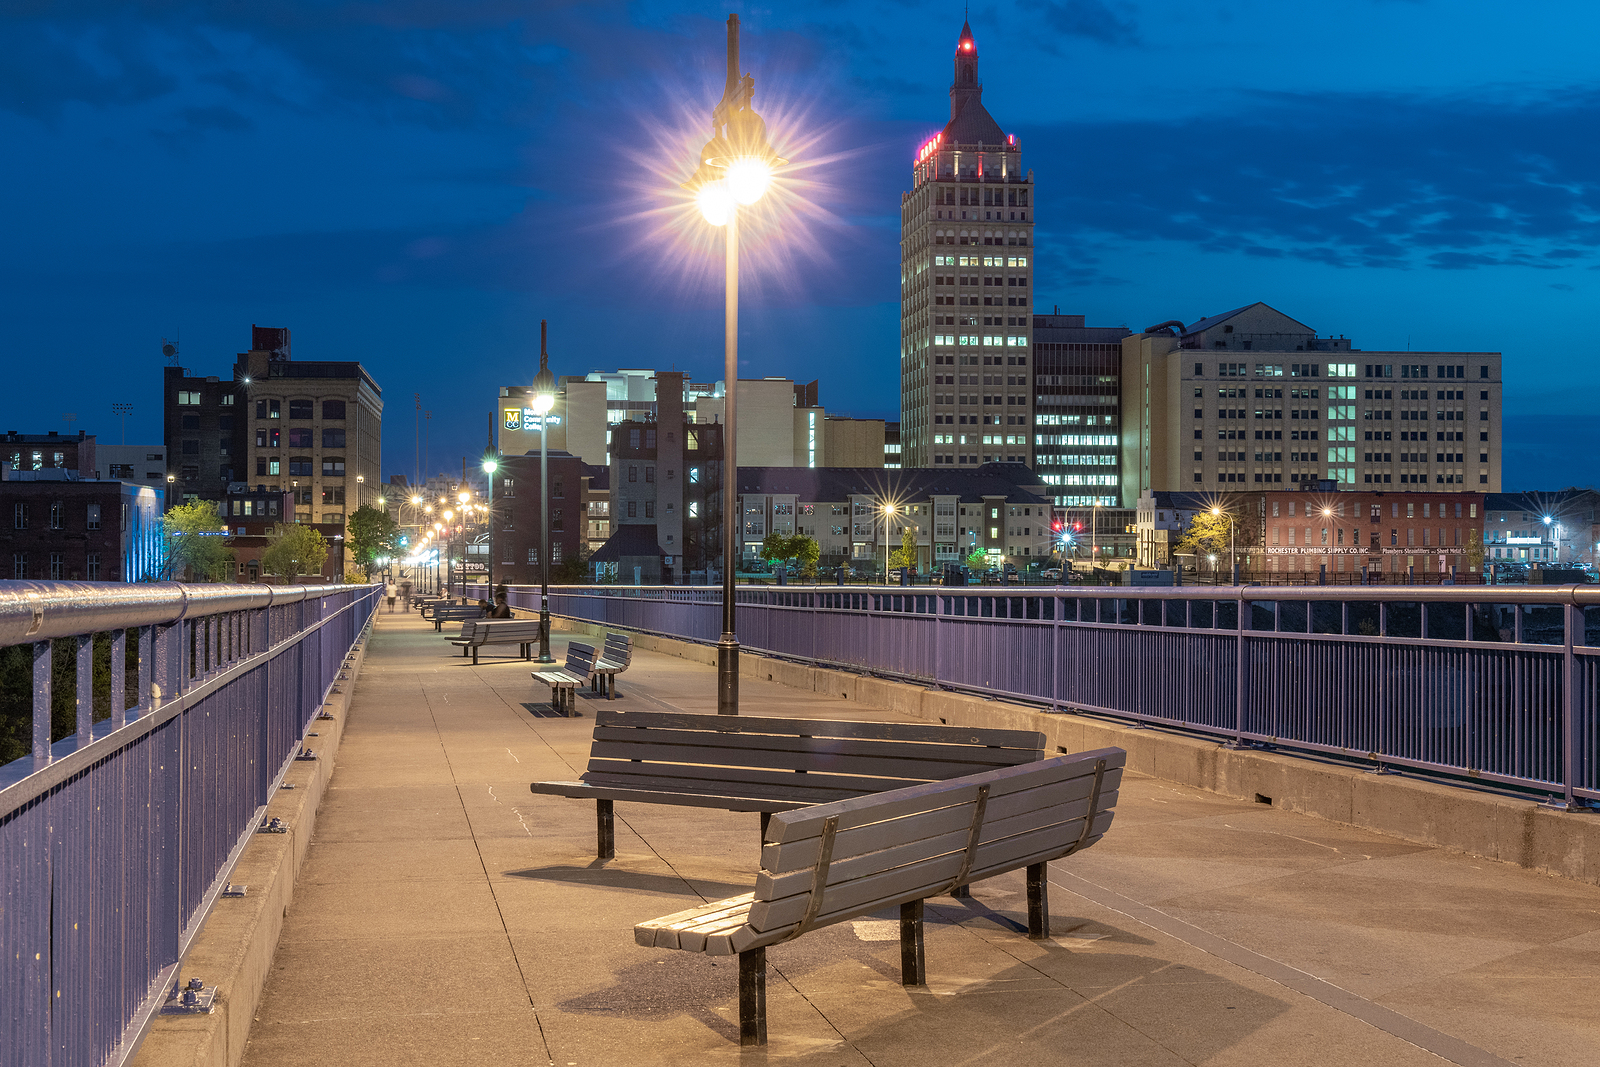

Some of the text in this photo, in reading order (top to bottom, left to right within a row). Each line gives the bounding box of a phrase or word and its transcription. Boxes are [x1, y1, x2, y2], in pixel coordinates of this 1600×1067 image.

[506, 412, 519, 422] M
[523, 415, 561, 425] Commnity
[523, 422, 548, 432] Colleg
[1267, 547, 1299, 555] ROCHESTER
[1300, 547, 1327, 555] PLUMBING
